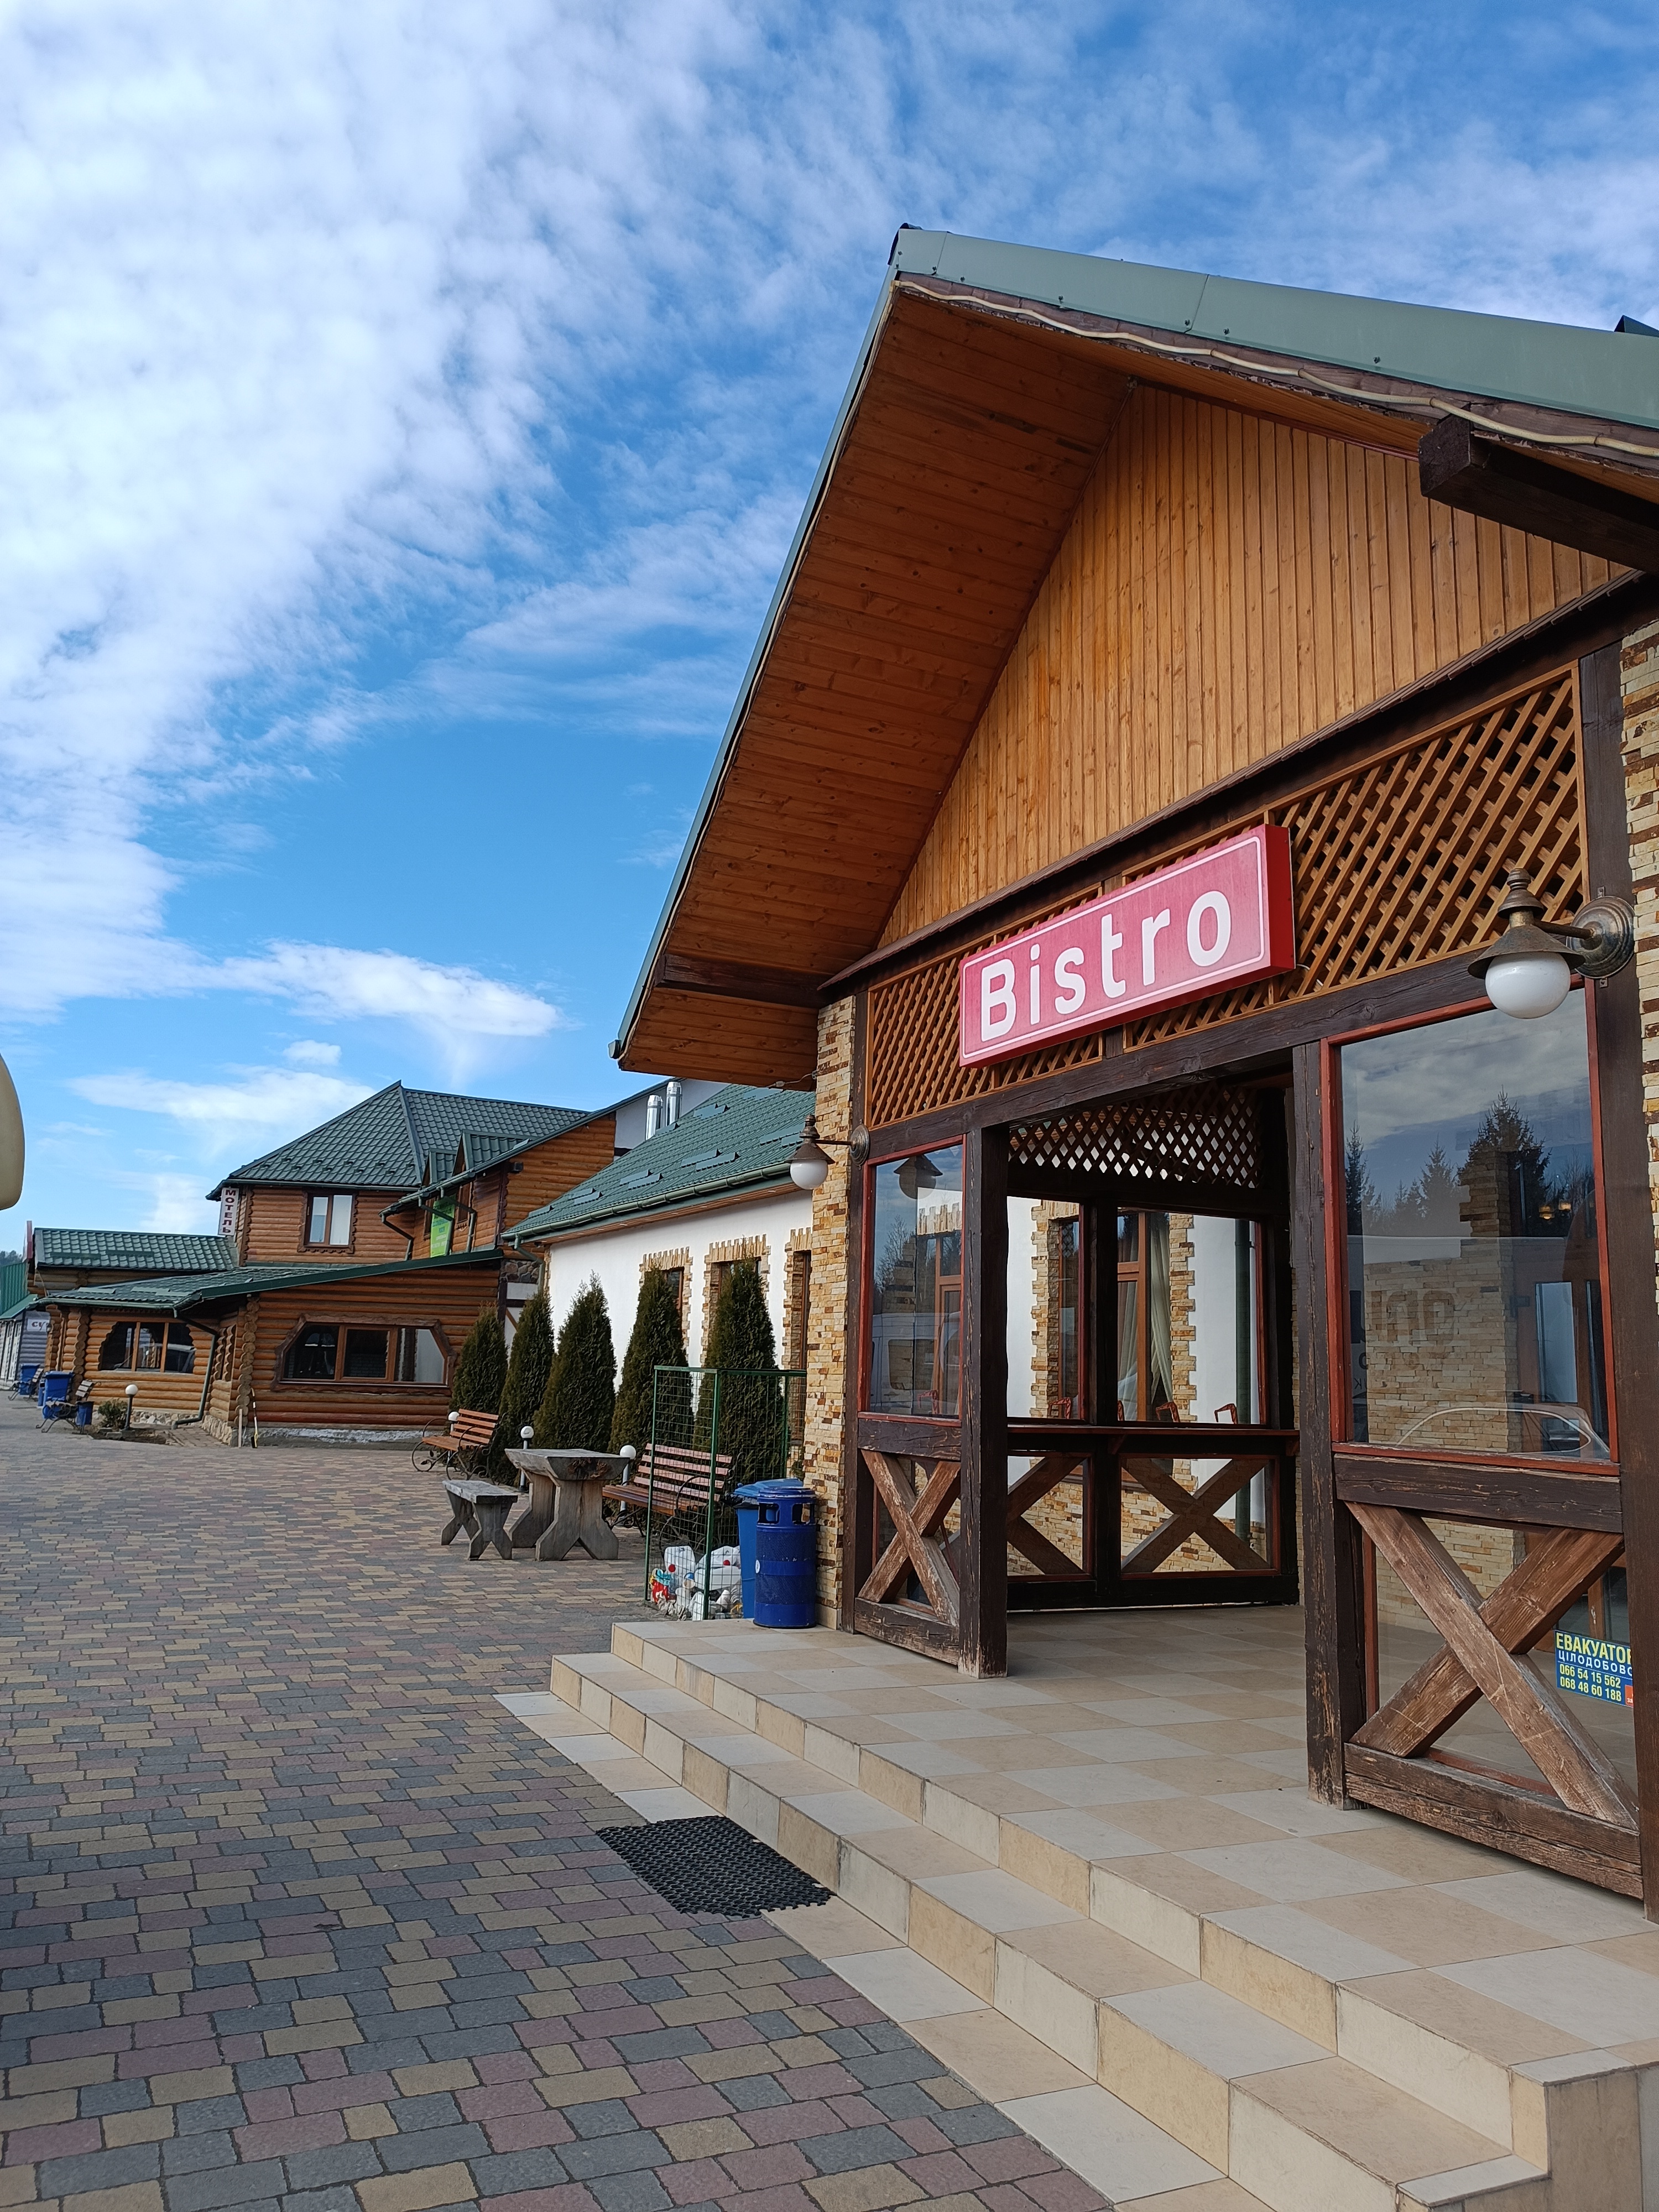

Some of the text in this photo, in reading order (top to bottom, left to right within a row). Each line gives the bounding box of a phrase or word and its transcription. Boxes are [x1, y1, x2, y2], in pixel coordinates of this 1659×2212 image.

[980, 890, 1232, 1042] Bistro
[222, 1190, 236, 1233] МОТЕЛЬ
[1559, 1663, 1621, 1689] 066 54 15 562
[1560, 1676, 1576, 1690] 068
[1578, 1681, 1589, 1693] 48
[1591, 1684, 1603, 1697] 60
[1605, 1688, 1622, 1702] 188
